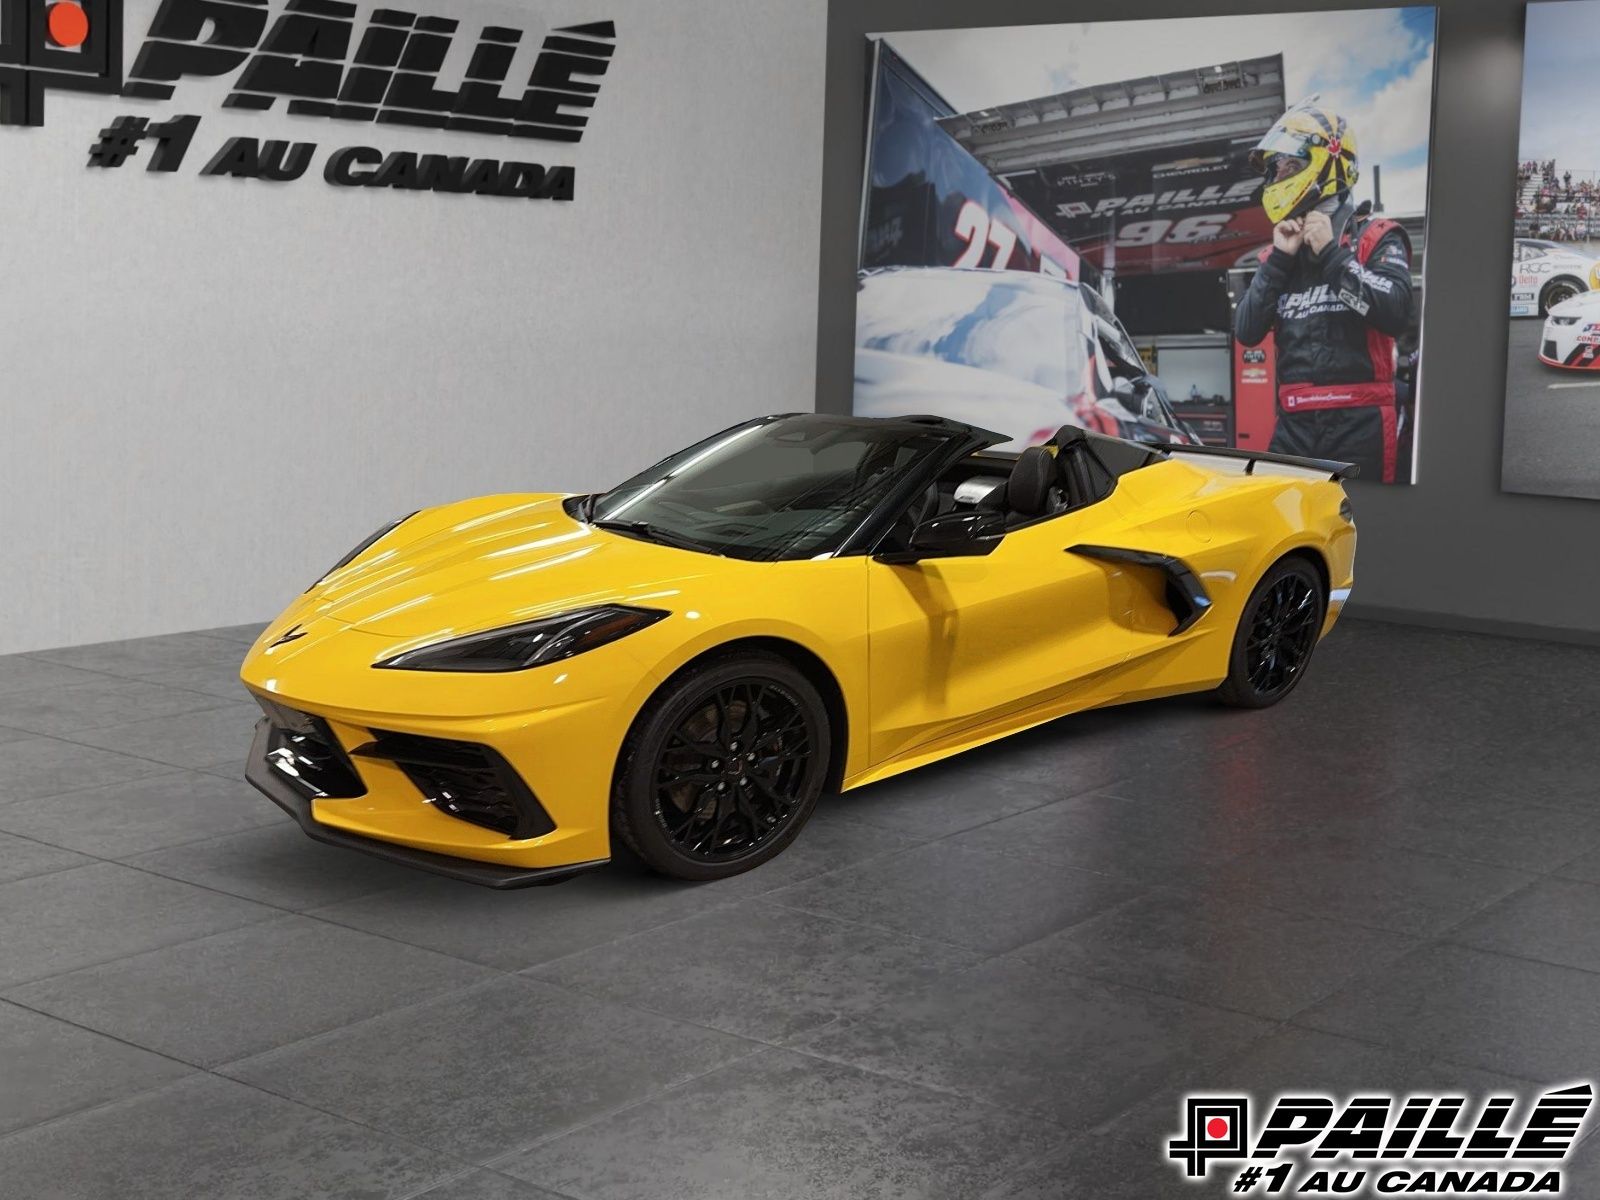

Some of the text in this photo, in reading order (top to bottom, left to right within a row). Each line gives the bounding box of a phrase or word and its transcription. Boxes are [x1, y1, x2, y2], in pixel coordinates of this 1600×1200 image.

[120, 0, 616, 143] PAILLÉ
[86, 114, 576, 201] #1 AU CANADA
[953, 200, 1017, 271] 27
[1115, 213, 1234, 247] 96
[1120, 205, 1150, 216] AU
[1157, 195, 1251, 212] CANADA
